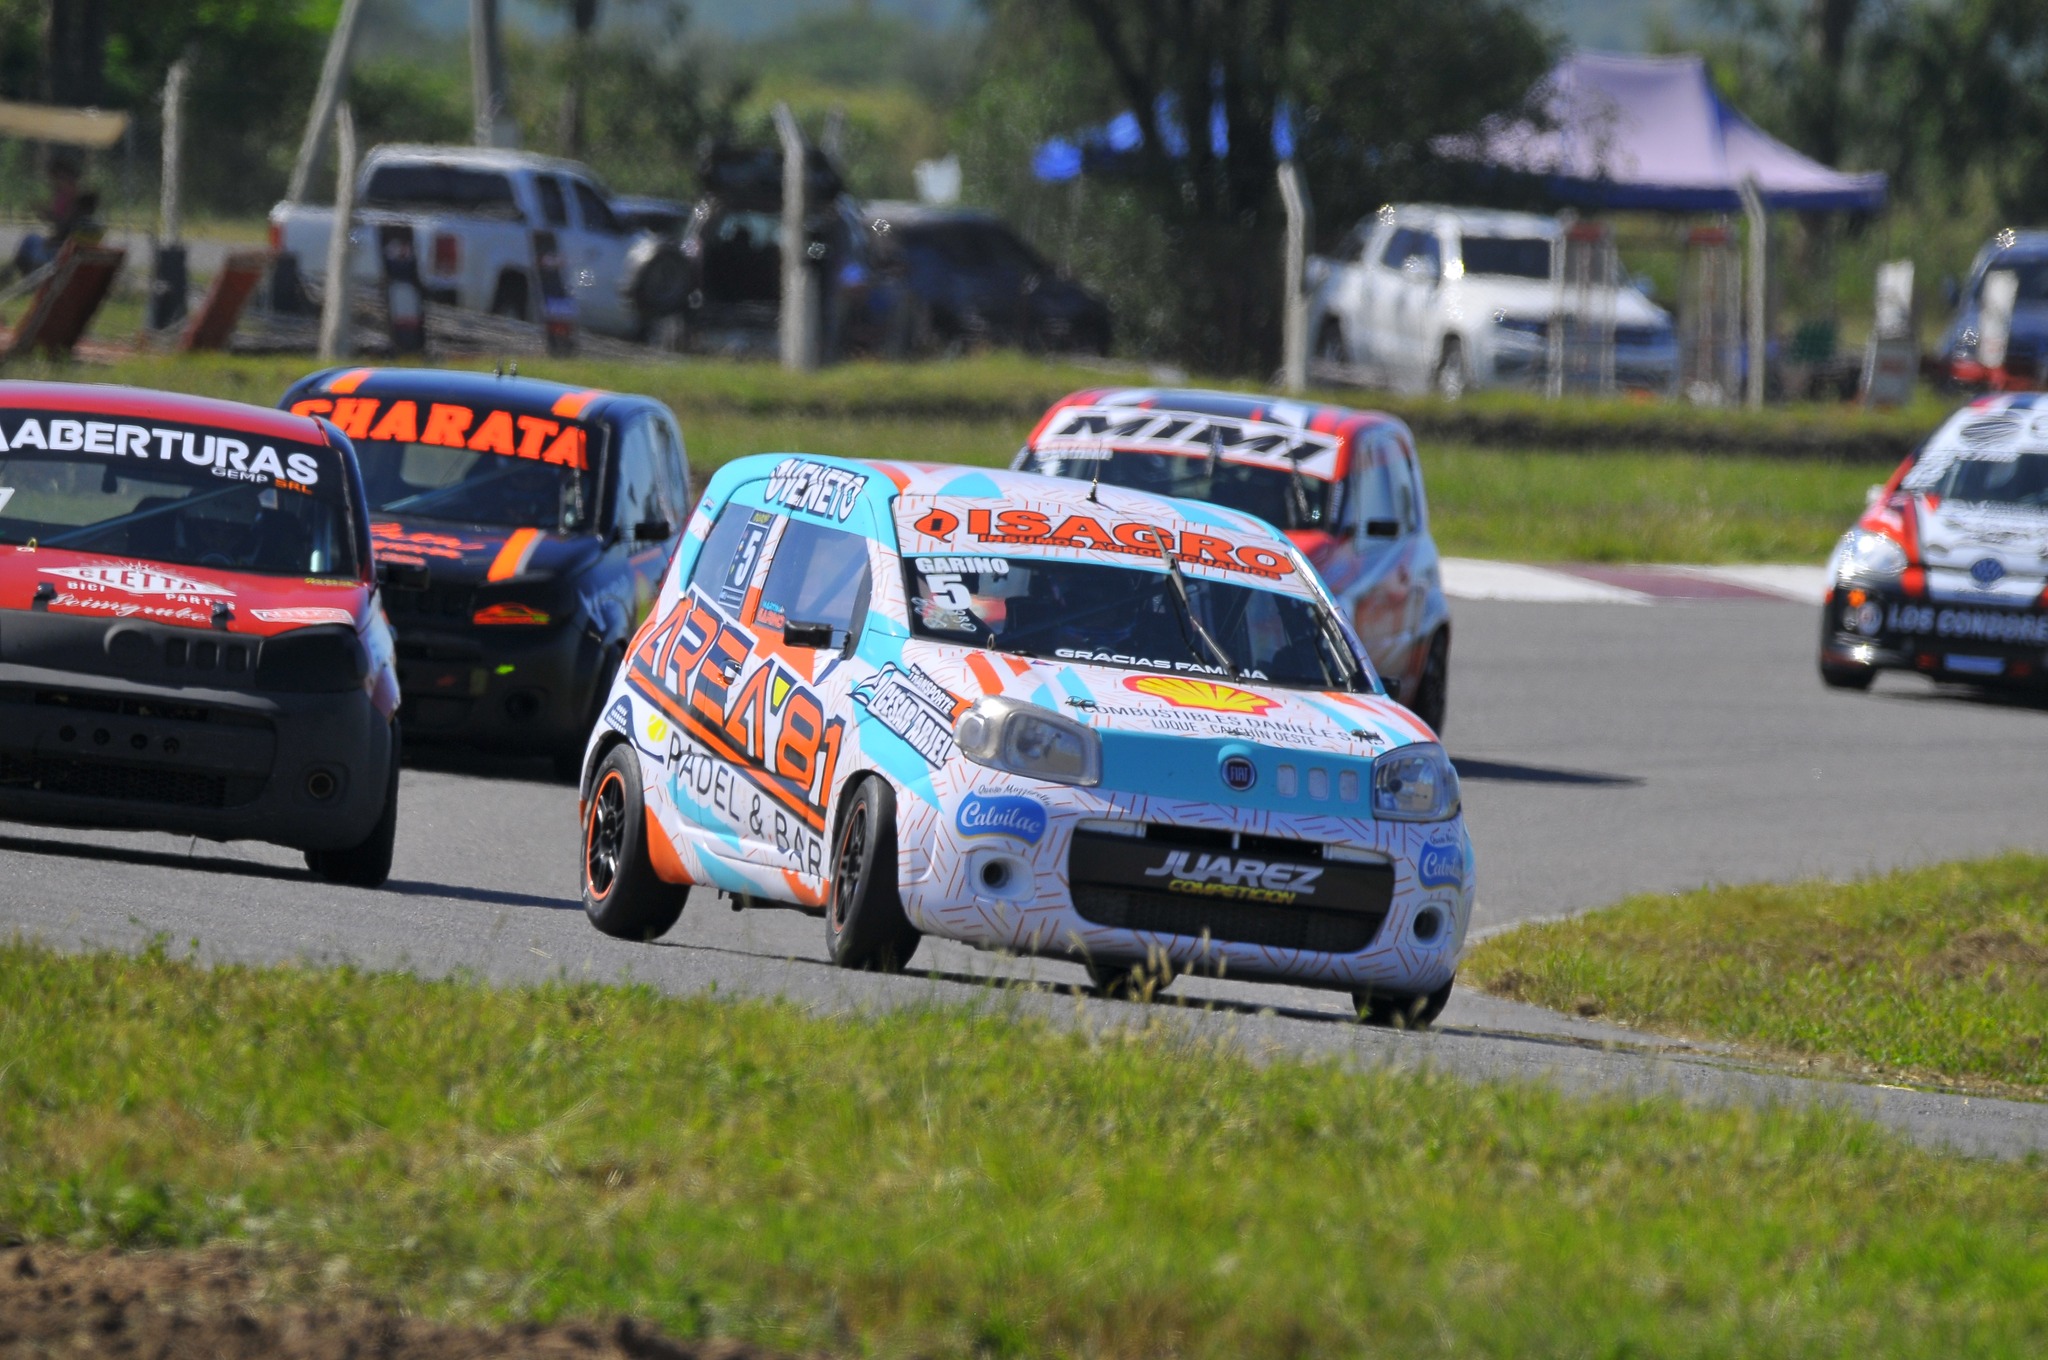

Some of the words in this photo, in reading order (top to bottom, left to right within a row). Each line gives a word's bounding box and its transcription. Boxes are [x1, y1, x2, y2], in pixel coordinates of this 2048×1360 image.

[735, 530, 763, 586] 5
[968, 508, 1296, 575] ISAGRO
[978, 534, 1086, 549] INSUMOS
[1088, 541, 1283, 581] AGROECUARIOS
[915, 557, 1009, 575] GARINO
[926, 574, 972, 611] 5
[1055, 648, 1171, 669] GRACIAS
[1175, 661, 1269, 681] FAMIIA
[1151, 718, 1200, 733] LUQUE
[1274, 730, 1318, 747] OESTE
[666, 731, 740, 822] PADEL
[750, 794, 765, 840] &
[775, 810, 824, 885] BAR
[960, 800, 1041, 834] Calvilac
[1144, 850, 1325, 895] JUAREZ
